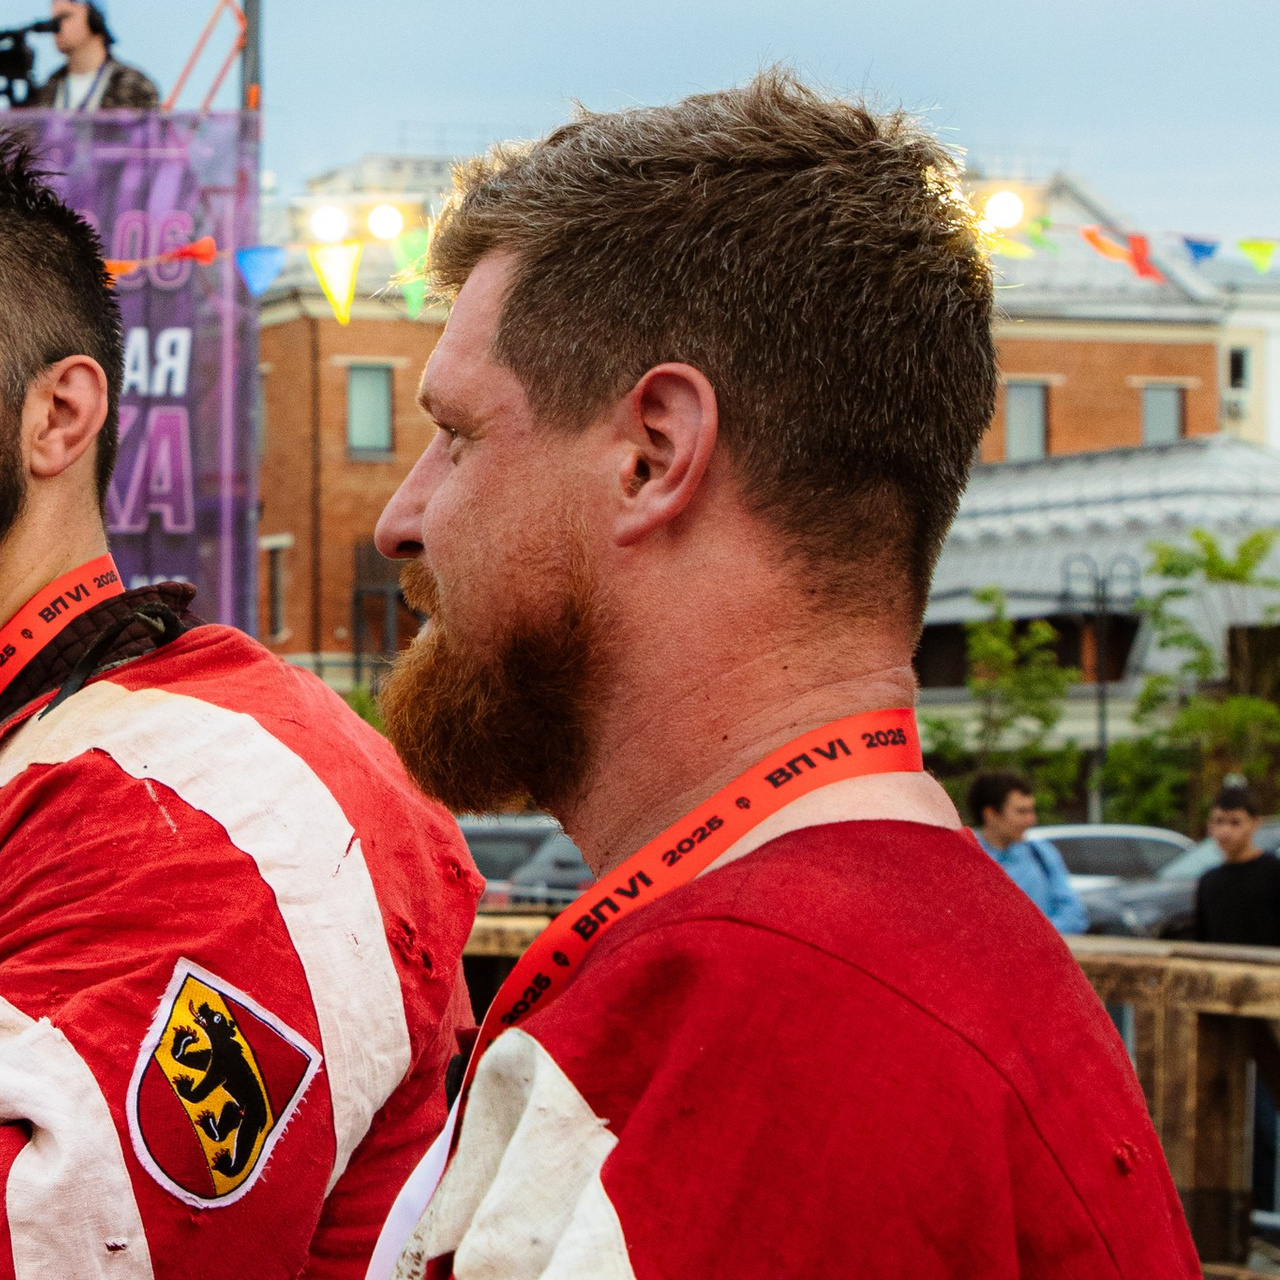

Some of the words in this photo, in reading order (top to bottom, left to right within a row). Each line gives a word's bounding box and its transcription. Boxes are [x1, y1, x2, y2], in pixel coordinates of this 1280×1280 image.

[38, 596, 70, 624] ВП
[64, 583, 91, 603] VI
[764, 753, 817, 789] ВП
[811, 738, 852, 761] VI
[861, 727, 907, 749] 2025
[571, 896, 621, 942] ВП
[613, 870, 654, 900] VI
[661, 815, 724, 867] 2025
[500, 972, 552, 1025] 2025
